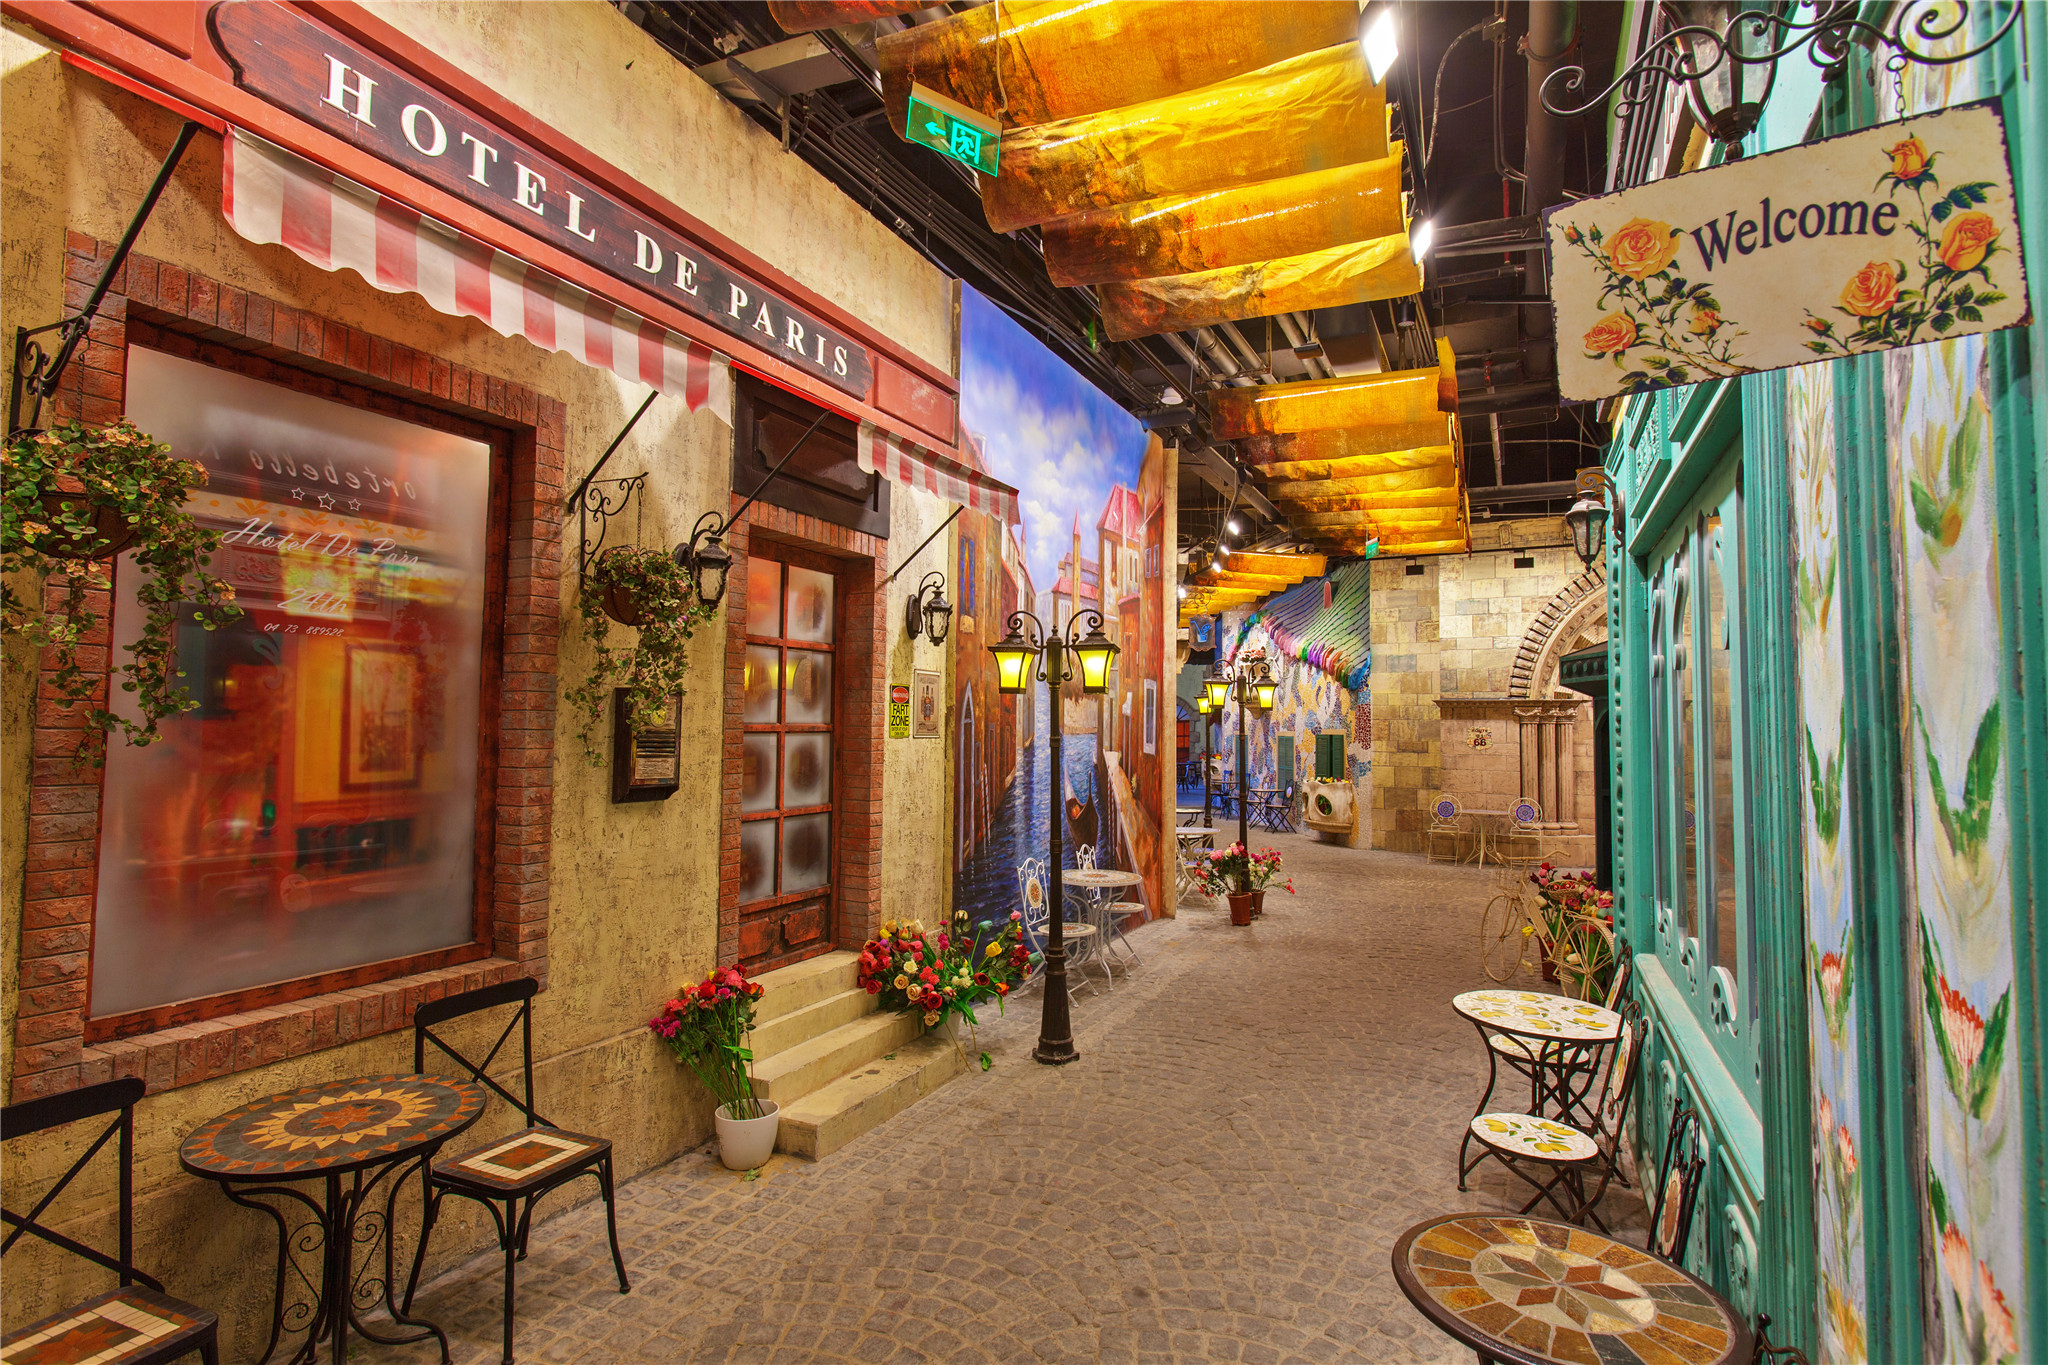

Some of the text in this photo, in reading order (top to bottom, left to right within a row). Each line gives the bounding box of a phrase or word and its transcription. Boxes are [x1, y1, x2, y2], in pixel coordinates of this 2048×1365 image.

[320, 53, 849, 376] HOTEL DE PARIS
[1690, 197, 1899, 272] Welcome
[221, 517, 322, 552] Hotel
[320, 532, 359, 558] De
[277, 588, 348, 614] 24th
[263, 622, 345, 637] 04 73 889528
[893, 704, 909, 715] FART
[891, 716, 909, 726] ZONE
[1473, 738, 1487, 747] 66
